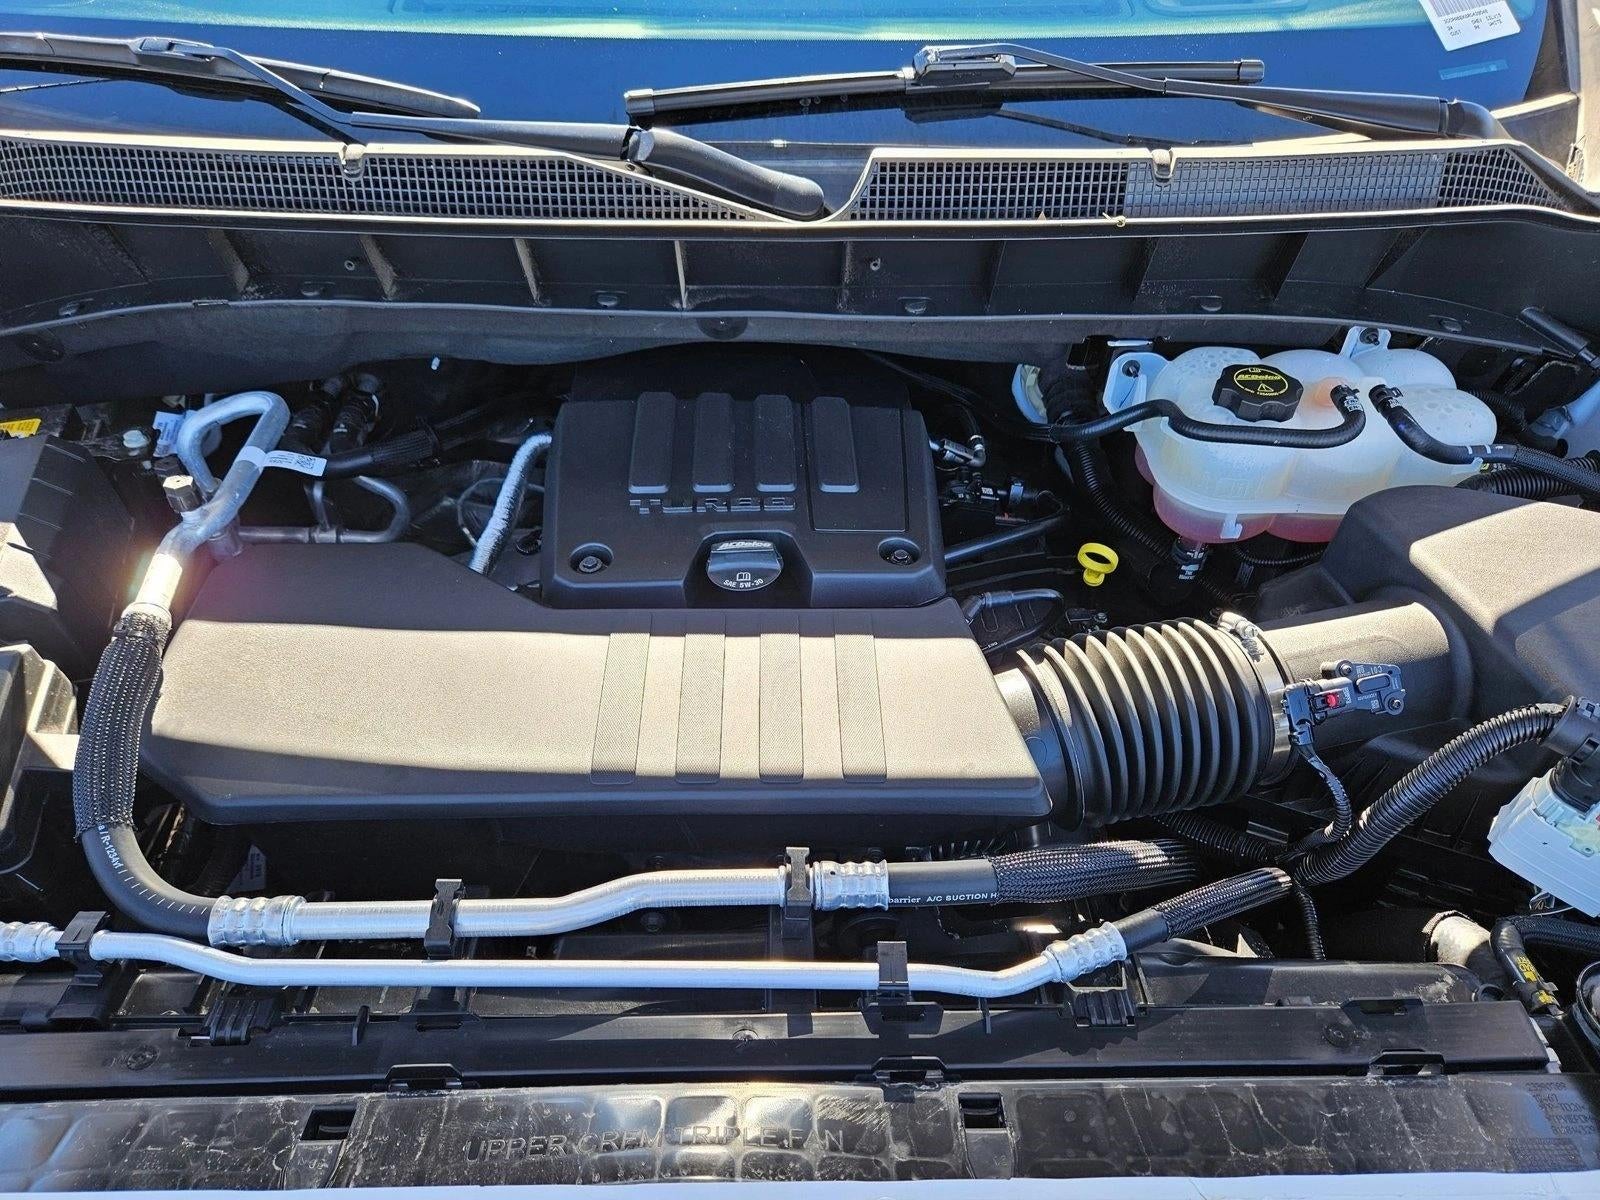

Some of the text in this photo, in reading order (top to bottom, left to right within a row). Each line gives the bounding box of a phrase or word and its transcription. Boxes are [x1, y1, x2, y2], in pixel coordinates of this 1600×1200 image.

[629, 497, 795, 515] TURBO
[716, 541, 771, 550] ACDelco
[723, 578, 764, 588] SAE 5W-30
[888, 896, 921, 904] barrier
[926, 895, 942, 903] A/C
[945, 892, 988, 901] SUCTION
[462, 1134, 568, 1163] UPPER
[674, 1124, 778, 1147] TRIPLE
[788, 1127, 845, 1151] FAN
